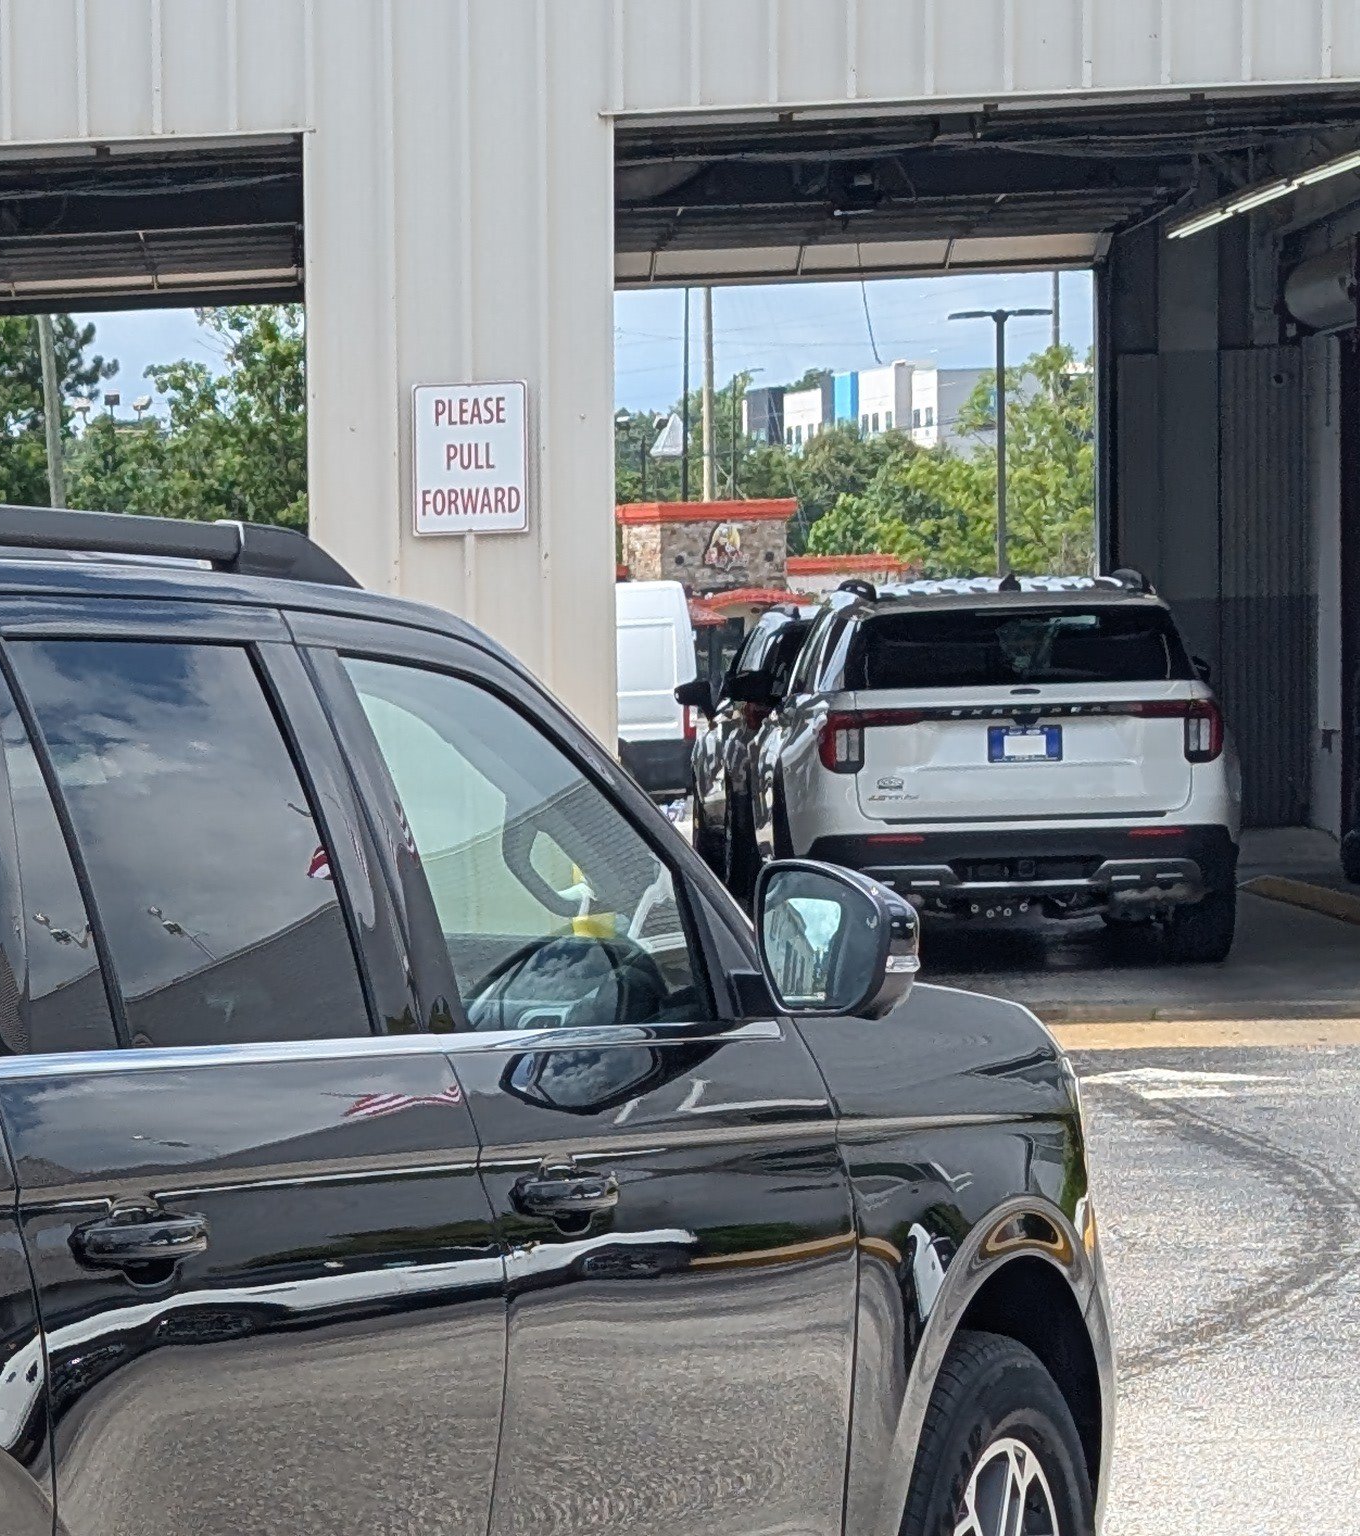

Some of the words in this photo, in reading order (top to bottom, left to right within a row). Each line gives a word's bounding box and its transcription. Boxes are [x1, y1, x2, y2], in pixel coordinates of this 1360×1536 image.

[434, 397, 506, 427] PLEASE
[446, 442, 495, 471] PULL
[421, 486, 521, 516] FORWARD
